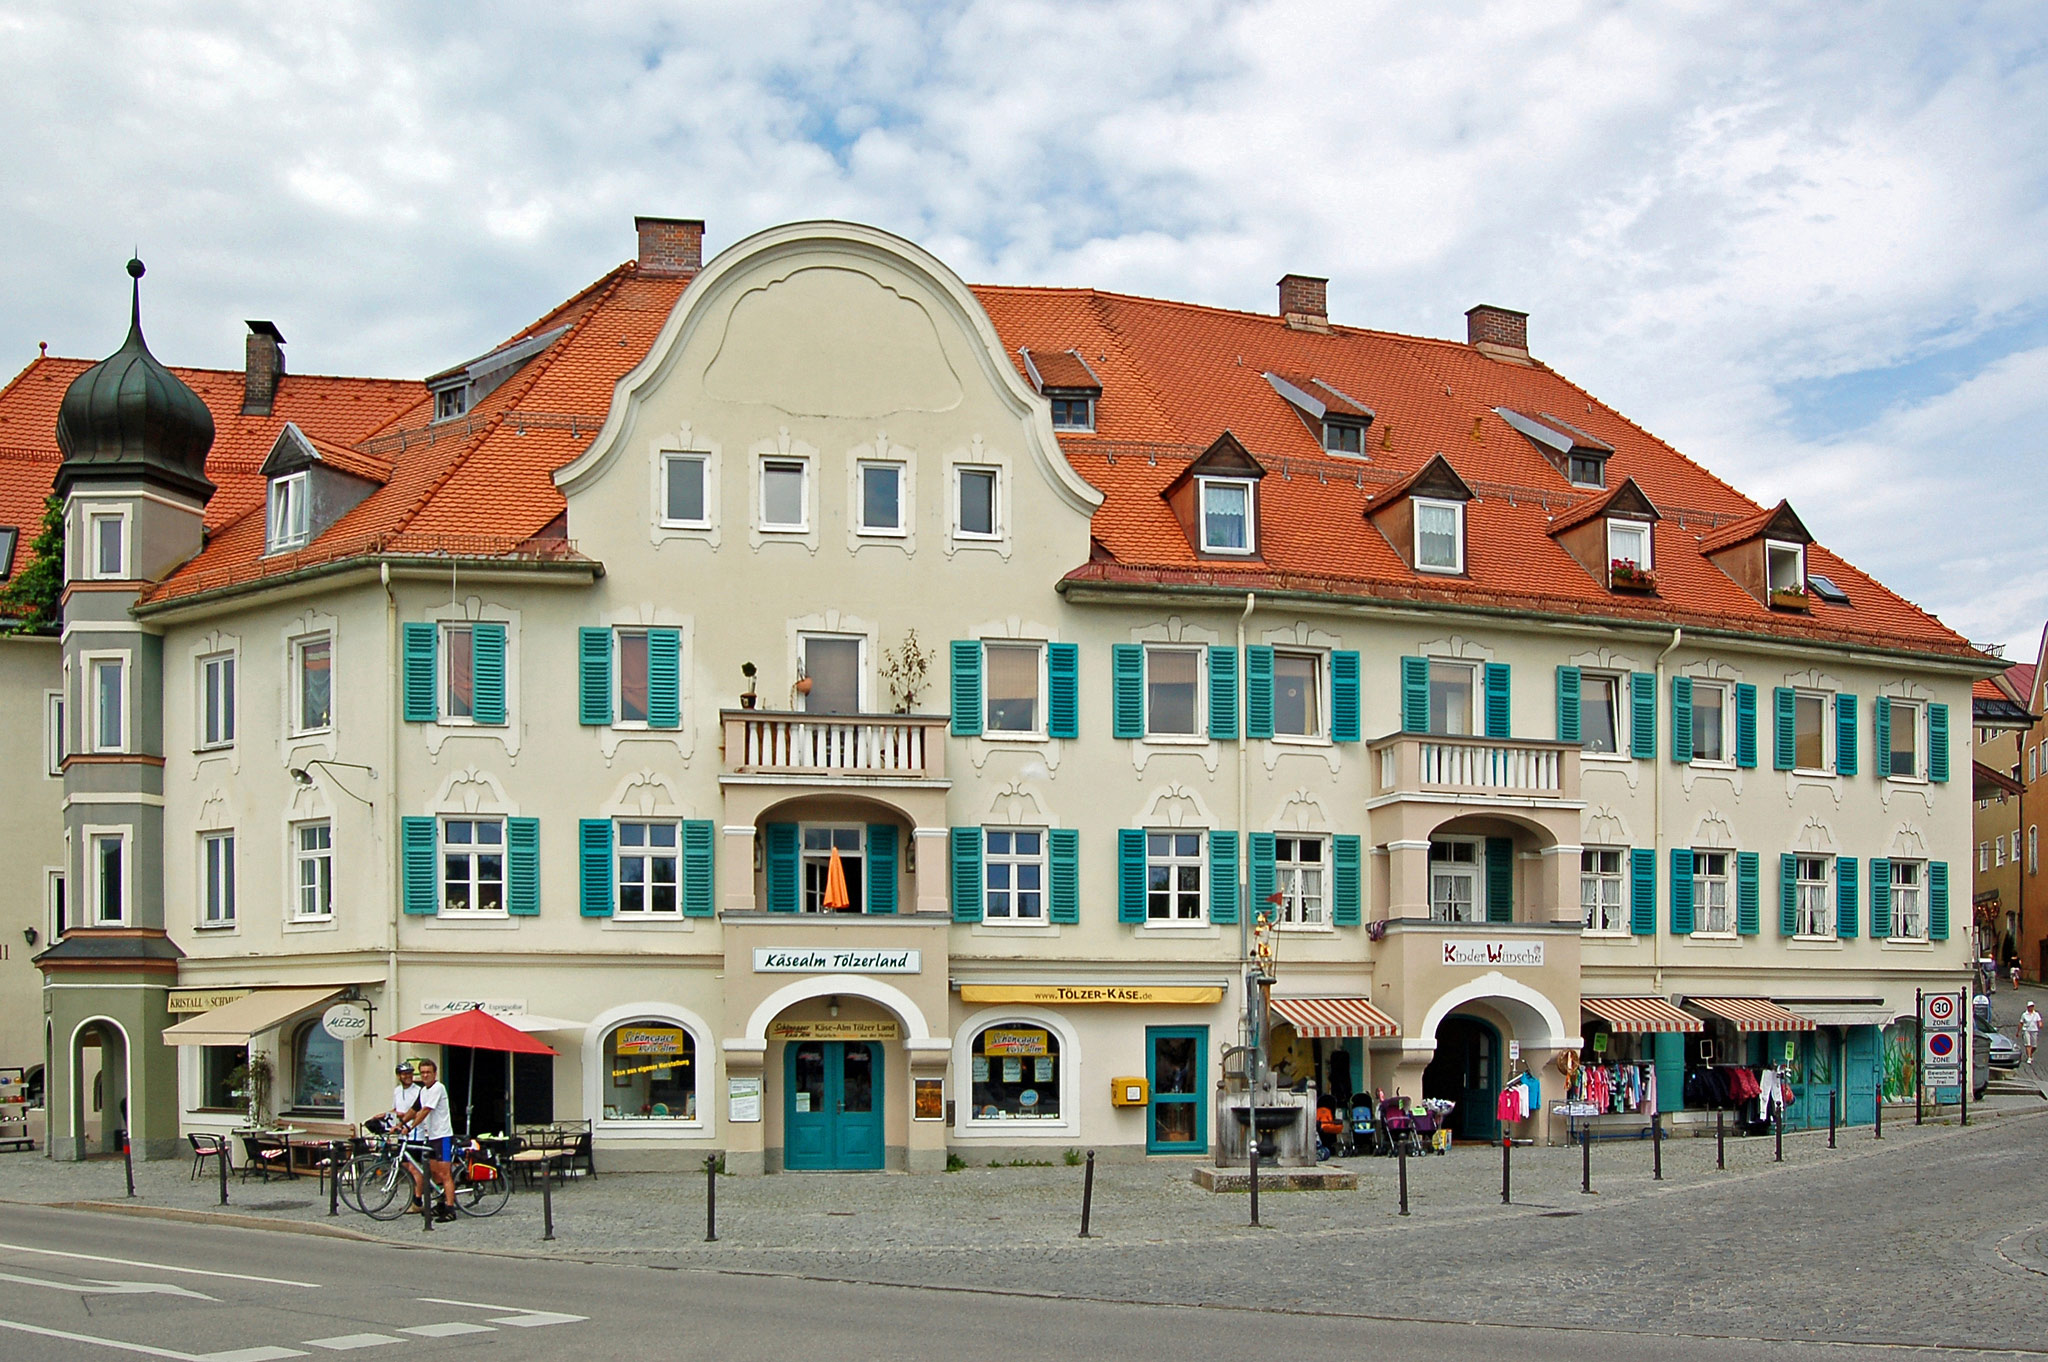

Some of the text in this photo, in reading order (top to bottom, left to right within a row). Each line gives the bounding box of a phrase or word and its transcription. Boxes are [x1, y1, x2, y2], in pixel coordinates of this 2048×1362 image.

[765, 952, 909, 968] Käsealm Tölzerland
[170, 997, 203, 1008] KRISTALL
[1934, 1002, 1949, 1013] 30
[326, 1016, 366, 1029] MEZZO
[876, 1023, 896, 1032] Land
